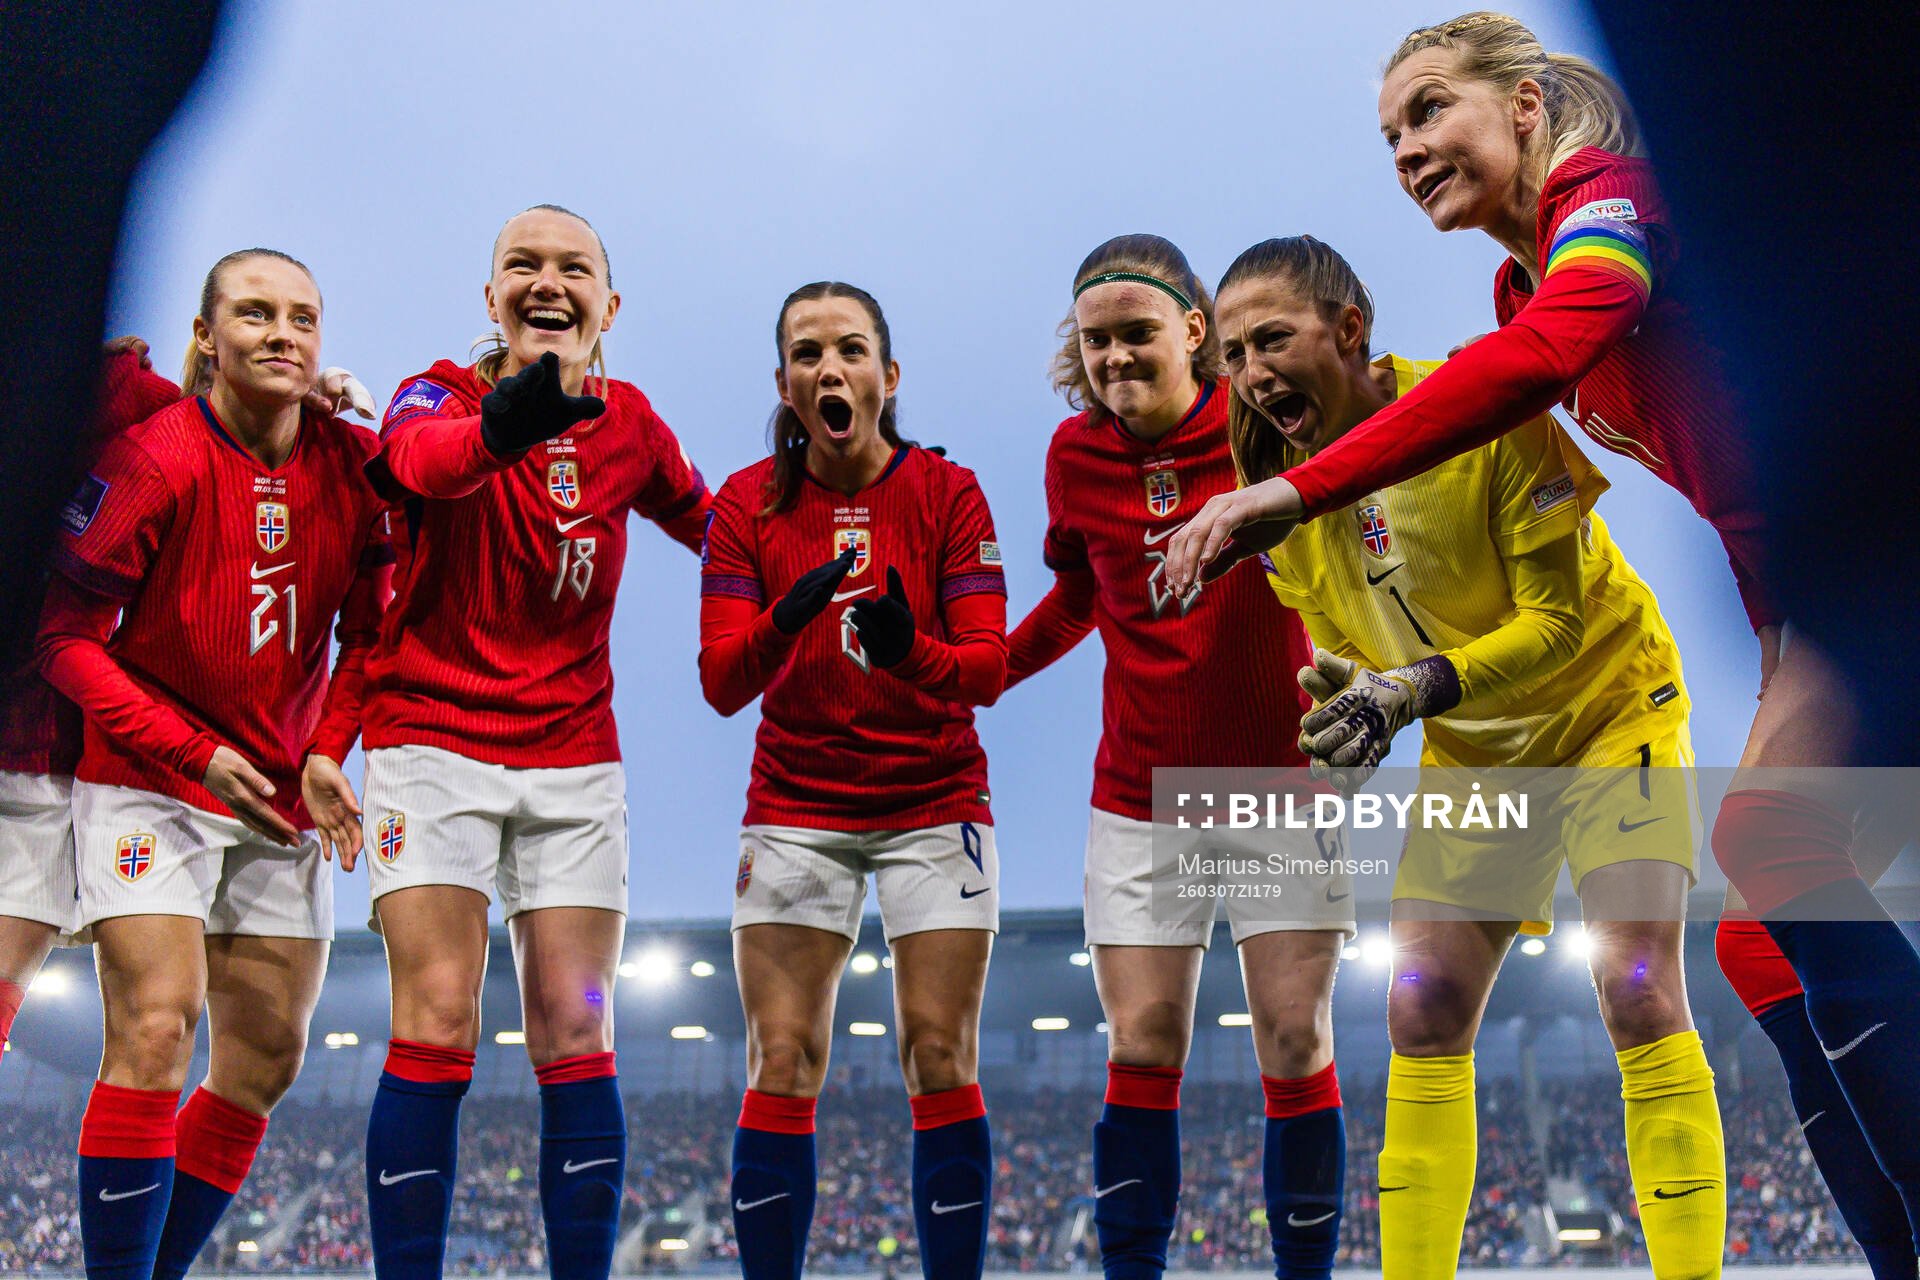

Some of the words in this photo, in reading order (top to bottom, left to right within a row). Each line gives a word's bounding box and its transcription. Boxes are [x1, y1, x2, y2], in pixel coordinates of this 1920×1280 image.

[254, 477, 271, 485] NOR
[550, 537, 597, 602] 18
[250, 584, 297, 657] 21
[1389, 586, 1435, 648] 1
[1367, 672, 1399, 692] PRED
